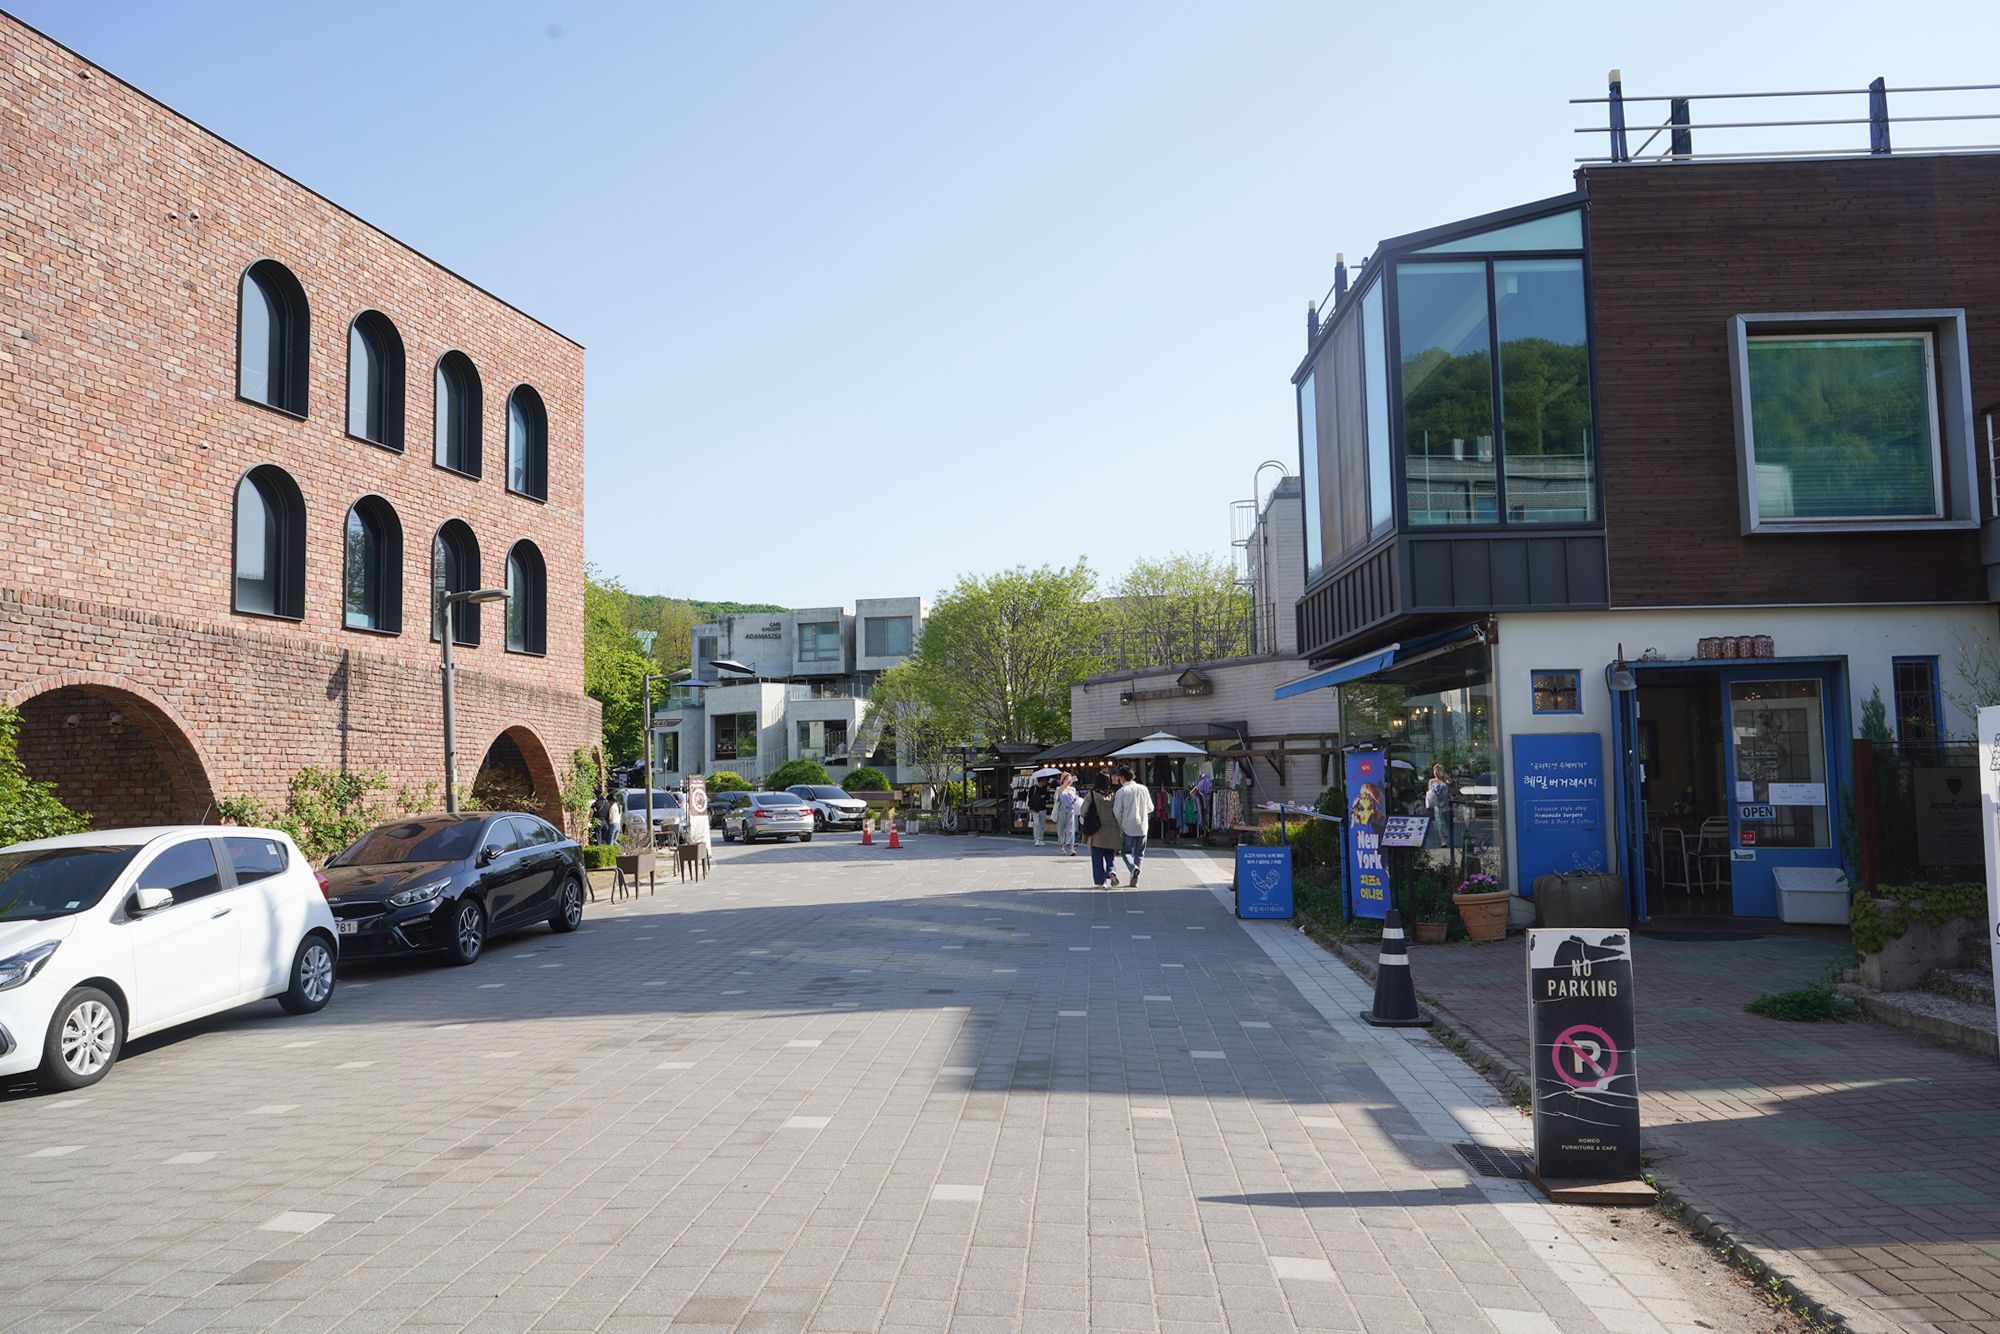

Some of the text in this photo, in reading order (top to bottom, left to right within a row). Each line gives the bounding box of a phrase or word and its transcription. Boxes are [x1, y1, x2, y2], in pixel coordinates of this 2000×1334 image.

[1743, 806, 1773, 818] OPEN
[1357, 830, 1379, 850] New
[1356, 850, 1382, 870] York
[1360, 888, 1383, 900] 어니언
[1572, 959, 1592, 977] NO
[1548, 980, 1618, 997] PARKING
